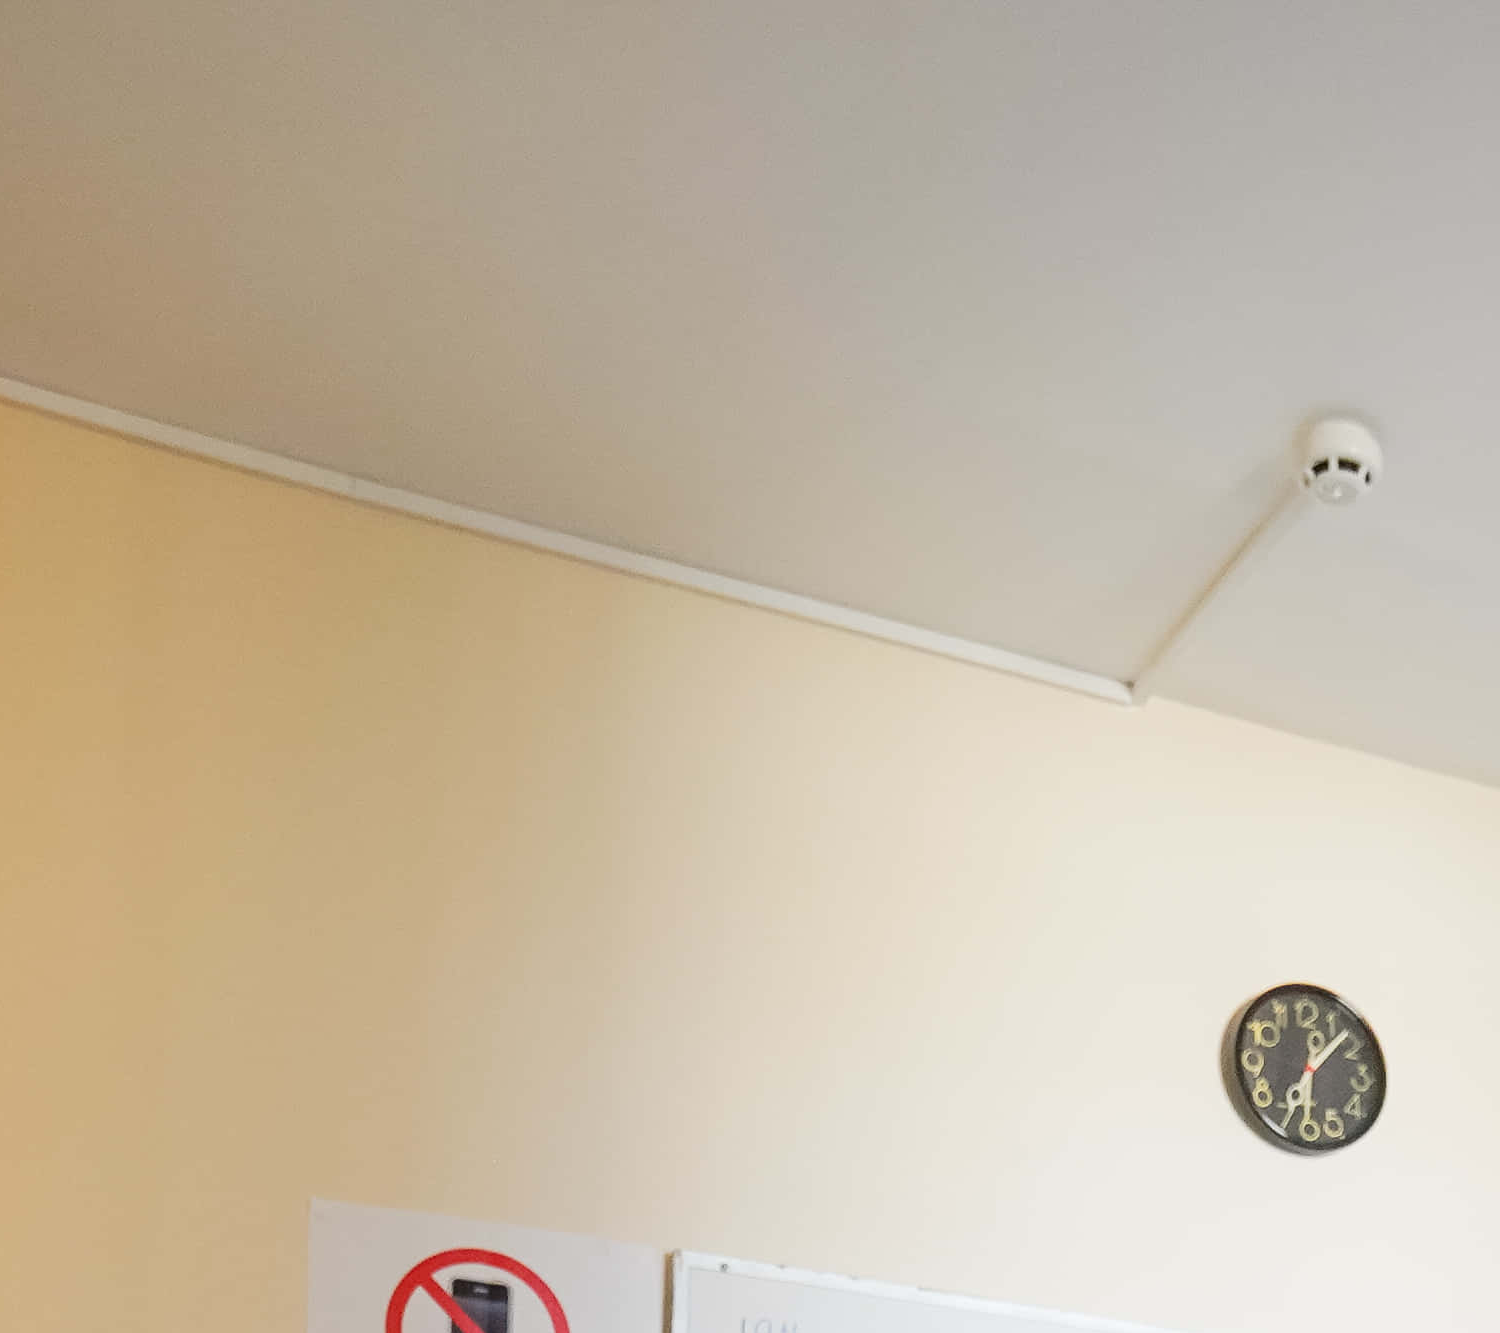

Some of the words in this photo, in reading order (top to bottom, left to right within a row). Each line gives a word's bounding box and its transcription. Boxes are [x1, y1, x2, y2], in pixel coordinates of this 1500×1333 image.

[1247, 1019, 1280, 1048] 10
[1325, 1010, 1337, 1036] 1
[1343, 1033, 1365, 1060] 2
[1241, 1048, 1264, 1079] 9
[1351, 1062, 1375, 1092] 3
[1253, 1077, 1273, 1109] 8
[1344, 1093, 1367, 1120] 4
[1323, 1107, 1345, 1140] 5
